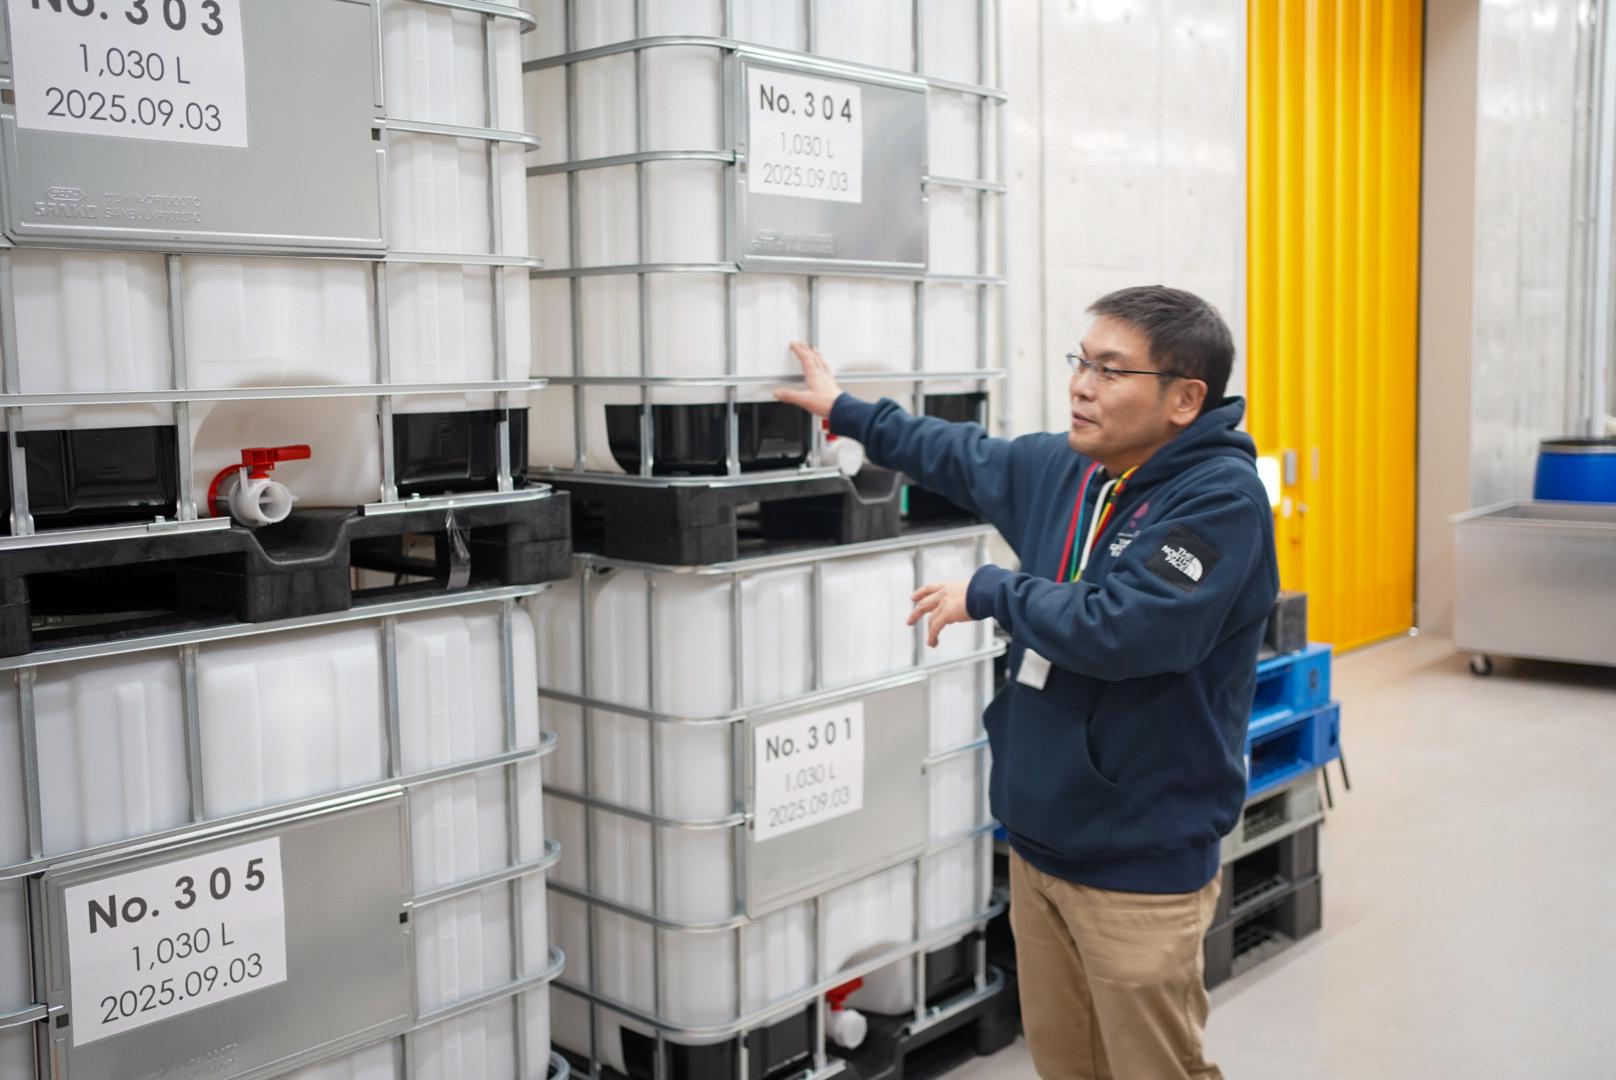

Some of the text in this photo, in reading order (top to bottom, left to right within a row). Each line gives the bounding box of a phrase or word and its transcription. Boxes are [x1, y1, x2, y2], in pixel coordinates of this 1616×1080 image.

[79, 44, 191, 85] 1,030 L
[45, 87, 222, 132] 2025.09.03
[780, 131, 835, 159] 1,030 L
[763, 162, 849, 193] 2025.09.03
[768, 786, 850, 827] 2025.09.03
[88, 893, 160, 935] No.
[132, 922, 235, 972] 1,030 L
[99, 952, 264, 1025] 2025.09.03
